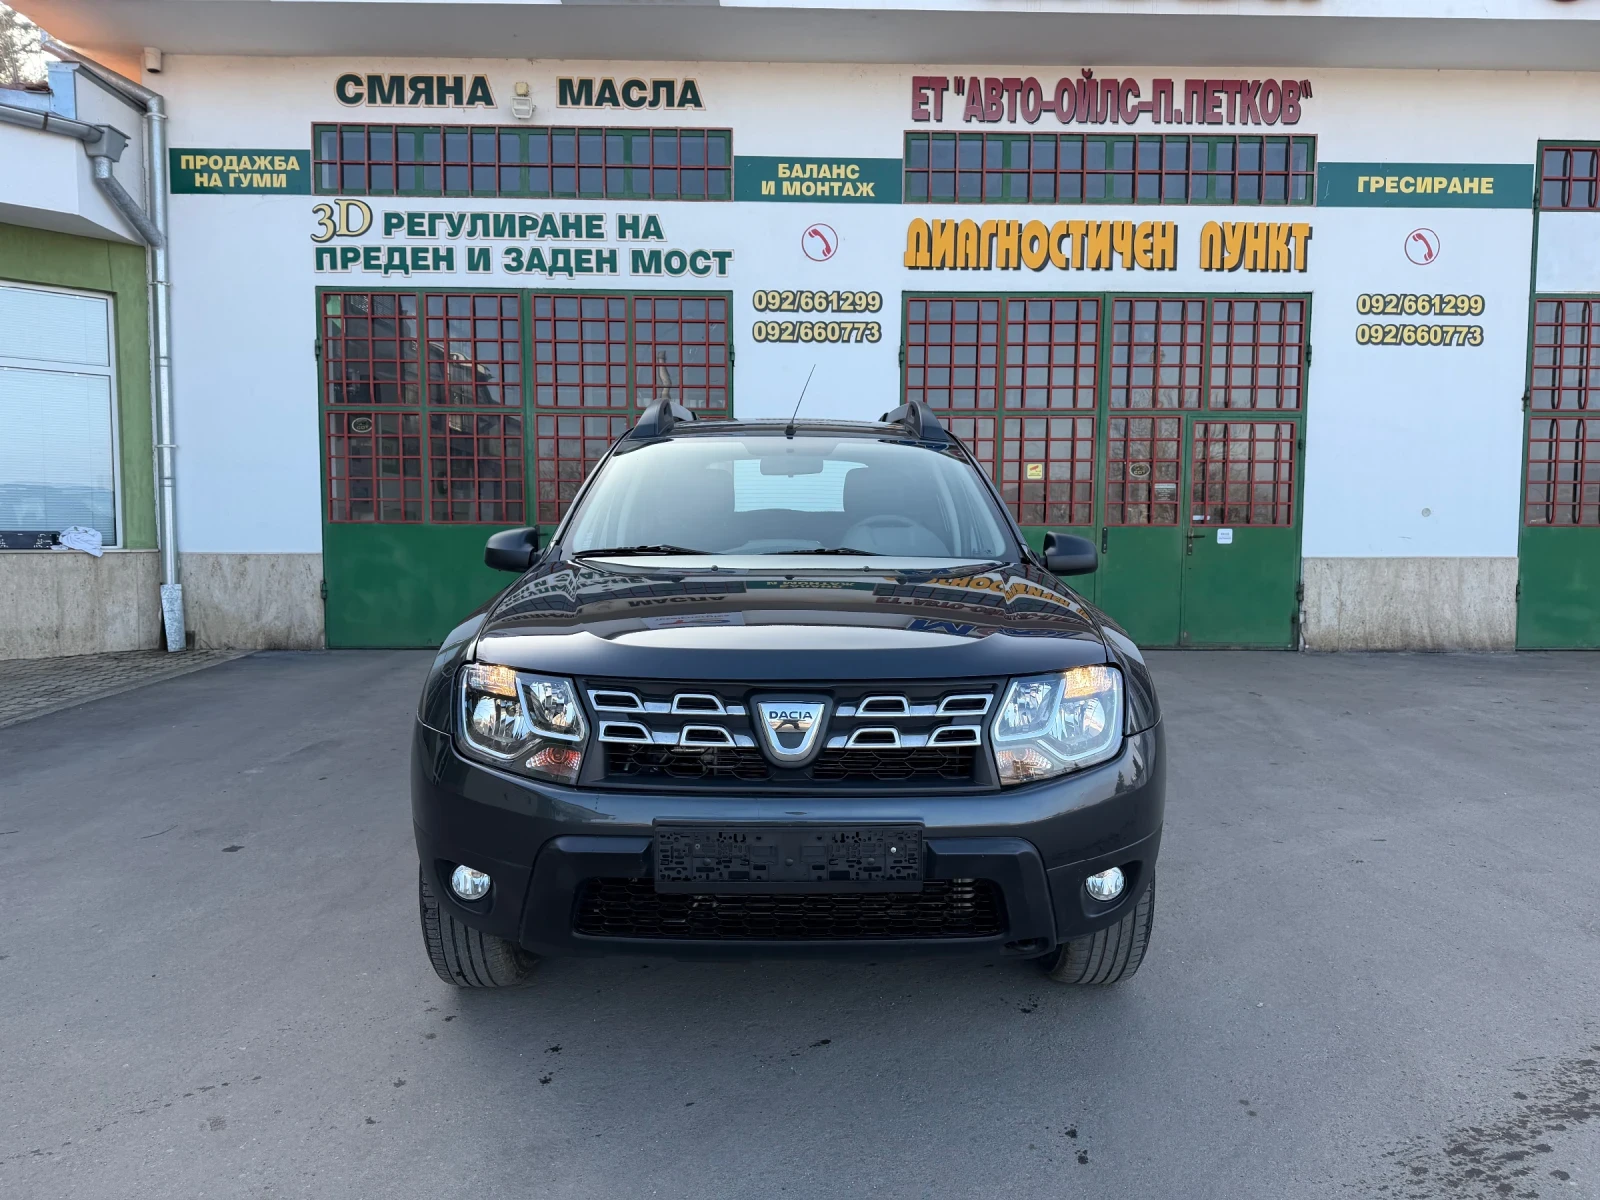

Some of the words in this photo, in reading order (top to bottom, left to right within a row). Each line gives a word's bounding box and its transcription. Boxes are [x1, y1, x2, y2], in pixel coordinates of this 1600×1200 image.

[335, 73, 496, 107] СМЯНА
[557, 77, 704, 109] МАСЛА
[912, 76, 949, 122] ЕТ
[954, 68, 1312, 125] "АВТО-ОЙЛС-П.ПЕТКОВ"
[180, 155, 300, 172] ПРОДАЖБА
[778, 164, 860, 179] БАЛАНС
[194, 173, 223, 187] НА
[229, 173, 287, 188] ГУМИ
[761, 181, 775, 195] И
[782, 181, 875, 197] МОНТАЖ
[1357, 176, 1494, 194] ГРЕСИРАНЕ
[310, 199, 373, 243] 3D
[383, 211, 606, 240] РЕГУЛИРАНЕ
[617, 213, 666, 241] НА
[904, 217, 1178, 271] ДИАГНОСТИЧЕН
[1200, 220, 1312, 273] ПУНКТ
[315, 246, 455, 276] ПРЕДЕН
[467, 247, 492, 273] И
[503, 247, 619, 278] ЗАДЕН
[631, 249, 734, 276] МОСТ
[753, 290, 882, 312] 092/661299
[1357, 294, 1484, 316] 092/661299
[753, 321, 882, 343] 092/660773
[1356, 324, 1483, 346] 092/660773
[768, 710, 813, 720] DACIA
